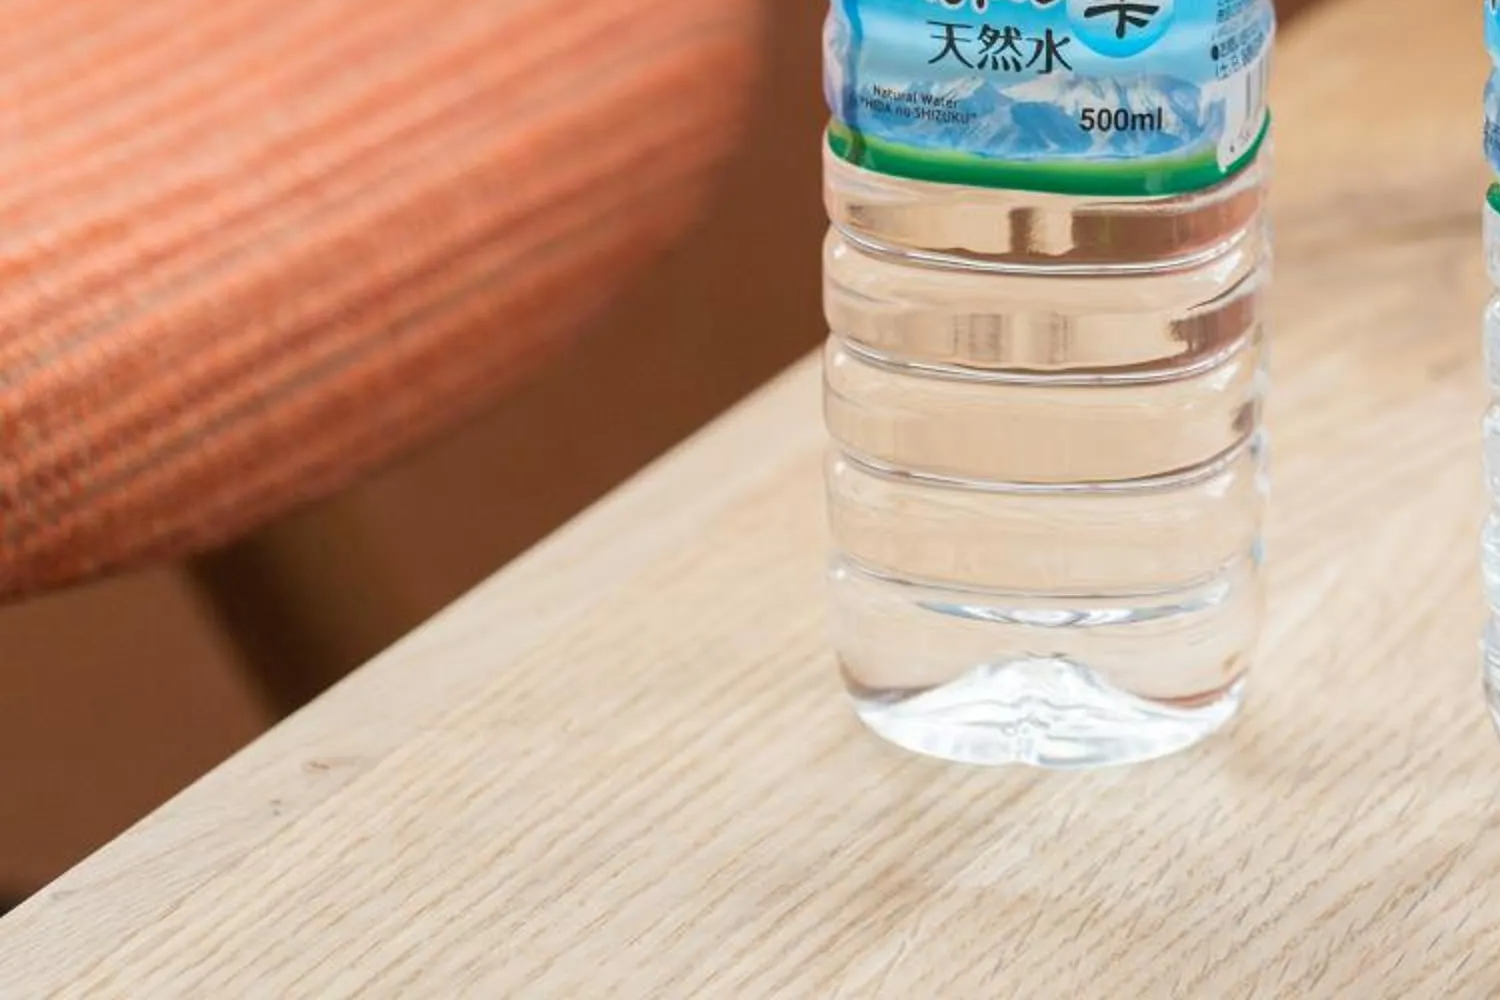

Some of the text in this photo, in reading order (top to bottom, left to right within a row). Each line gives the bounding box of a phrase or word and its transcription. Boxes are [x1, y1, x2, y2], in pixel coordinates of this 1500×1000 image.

[928, 20, 1073, 73] 天然水
[1080, 107, 1163, 132] 500ml
